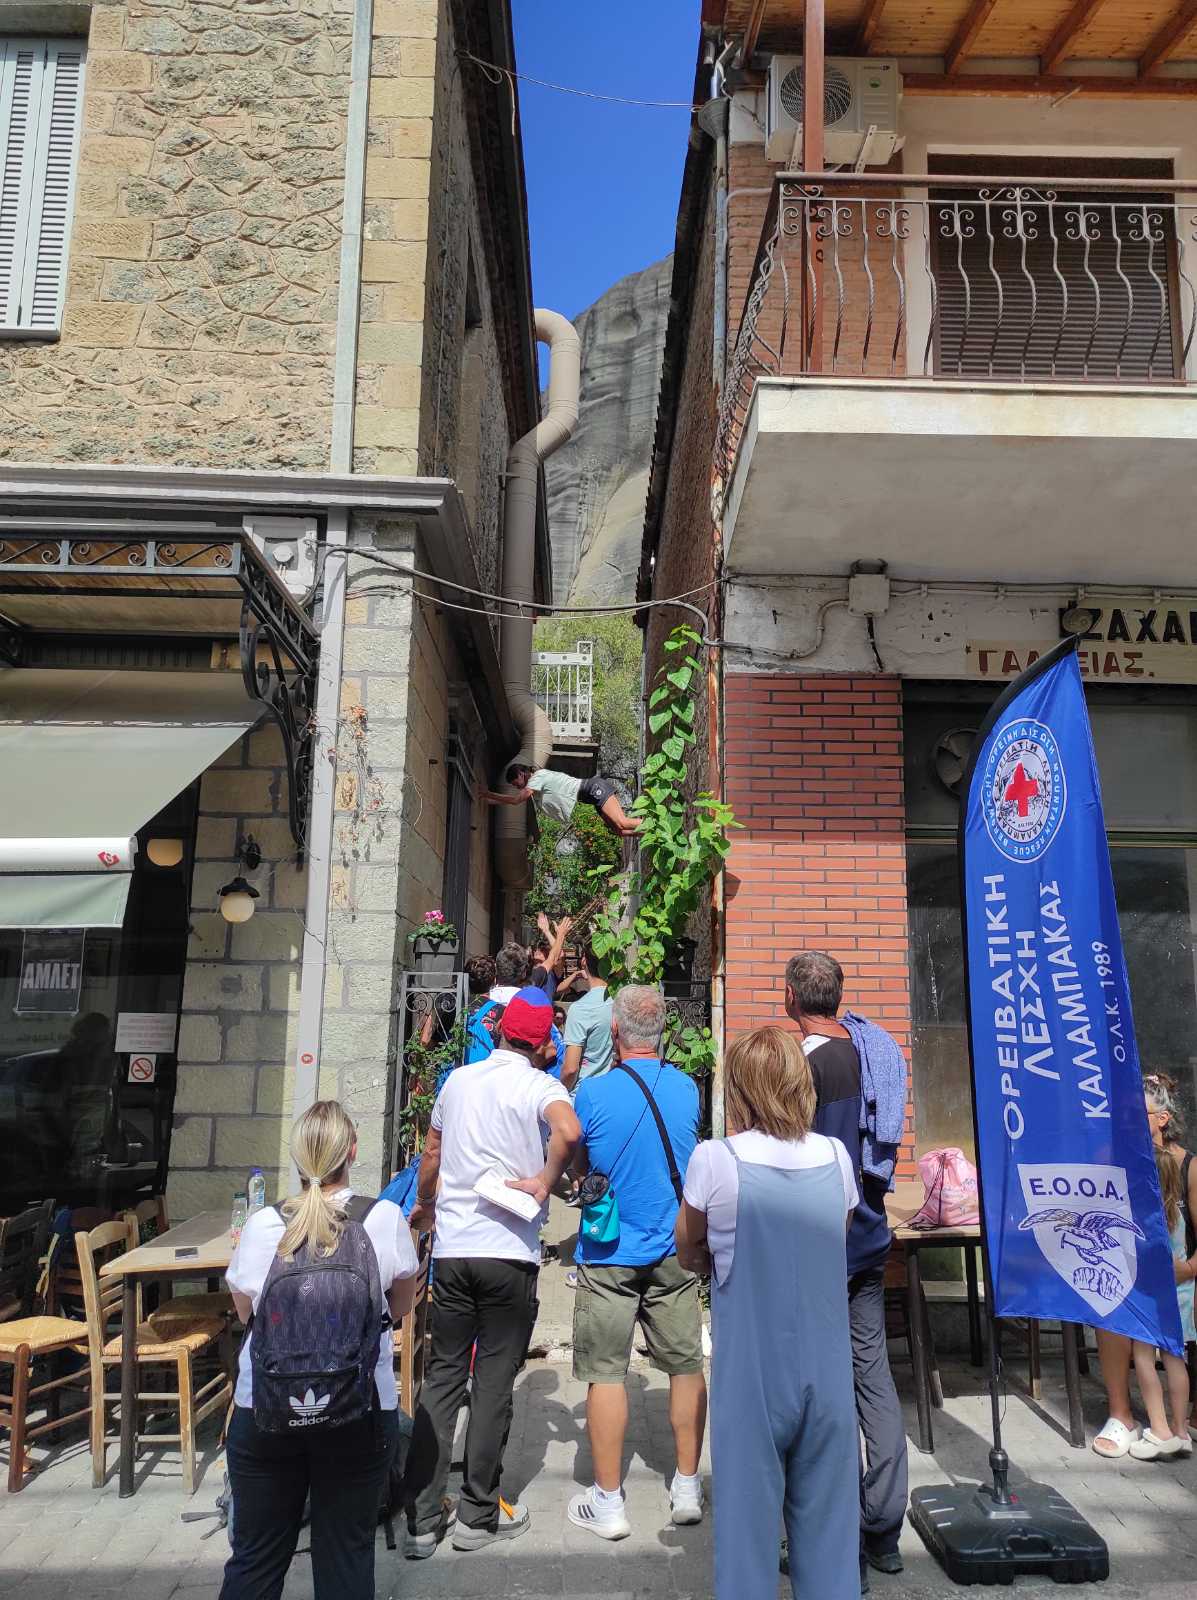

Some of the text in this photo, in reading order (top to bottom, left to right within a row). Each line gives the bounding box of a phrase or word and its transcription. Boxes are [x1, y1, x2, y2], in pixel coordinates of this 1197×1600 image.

[1044, 762, 1061, 835] MOUNTAIN
[1014, 835, 1046, 856] RESCUE
[22, 963, 81, 990] ΑΜΛΕΤ
[1091, 941, 1115, 988] 1989
[983, 874, 1025, 1140] ΟΡΕΙΒΑΤΙΚΗ
[1015, 930, 1061, 1081] ΛΕΣΧΗ
[1039, 880, 1111, 1119] ΚΑΛΑΜΠΑΚΑΣ
[1028, 1177, 1124, 1201] Ε.Ο.Ο.Α.
